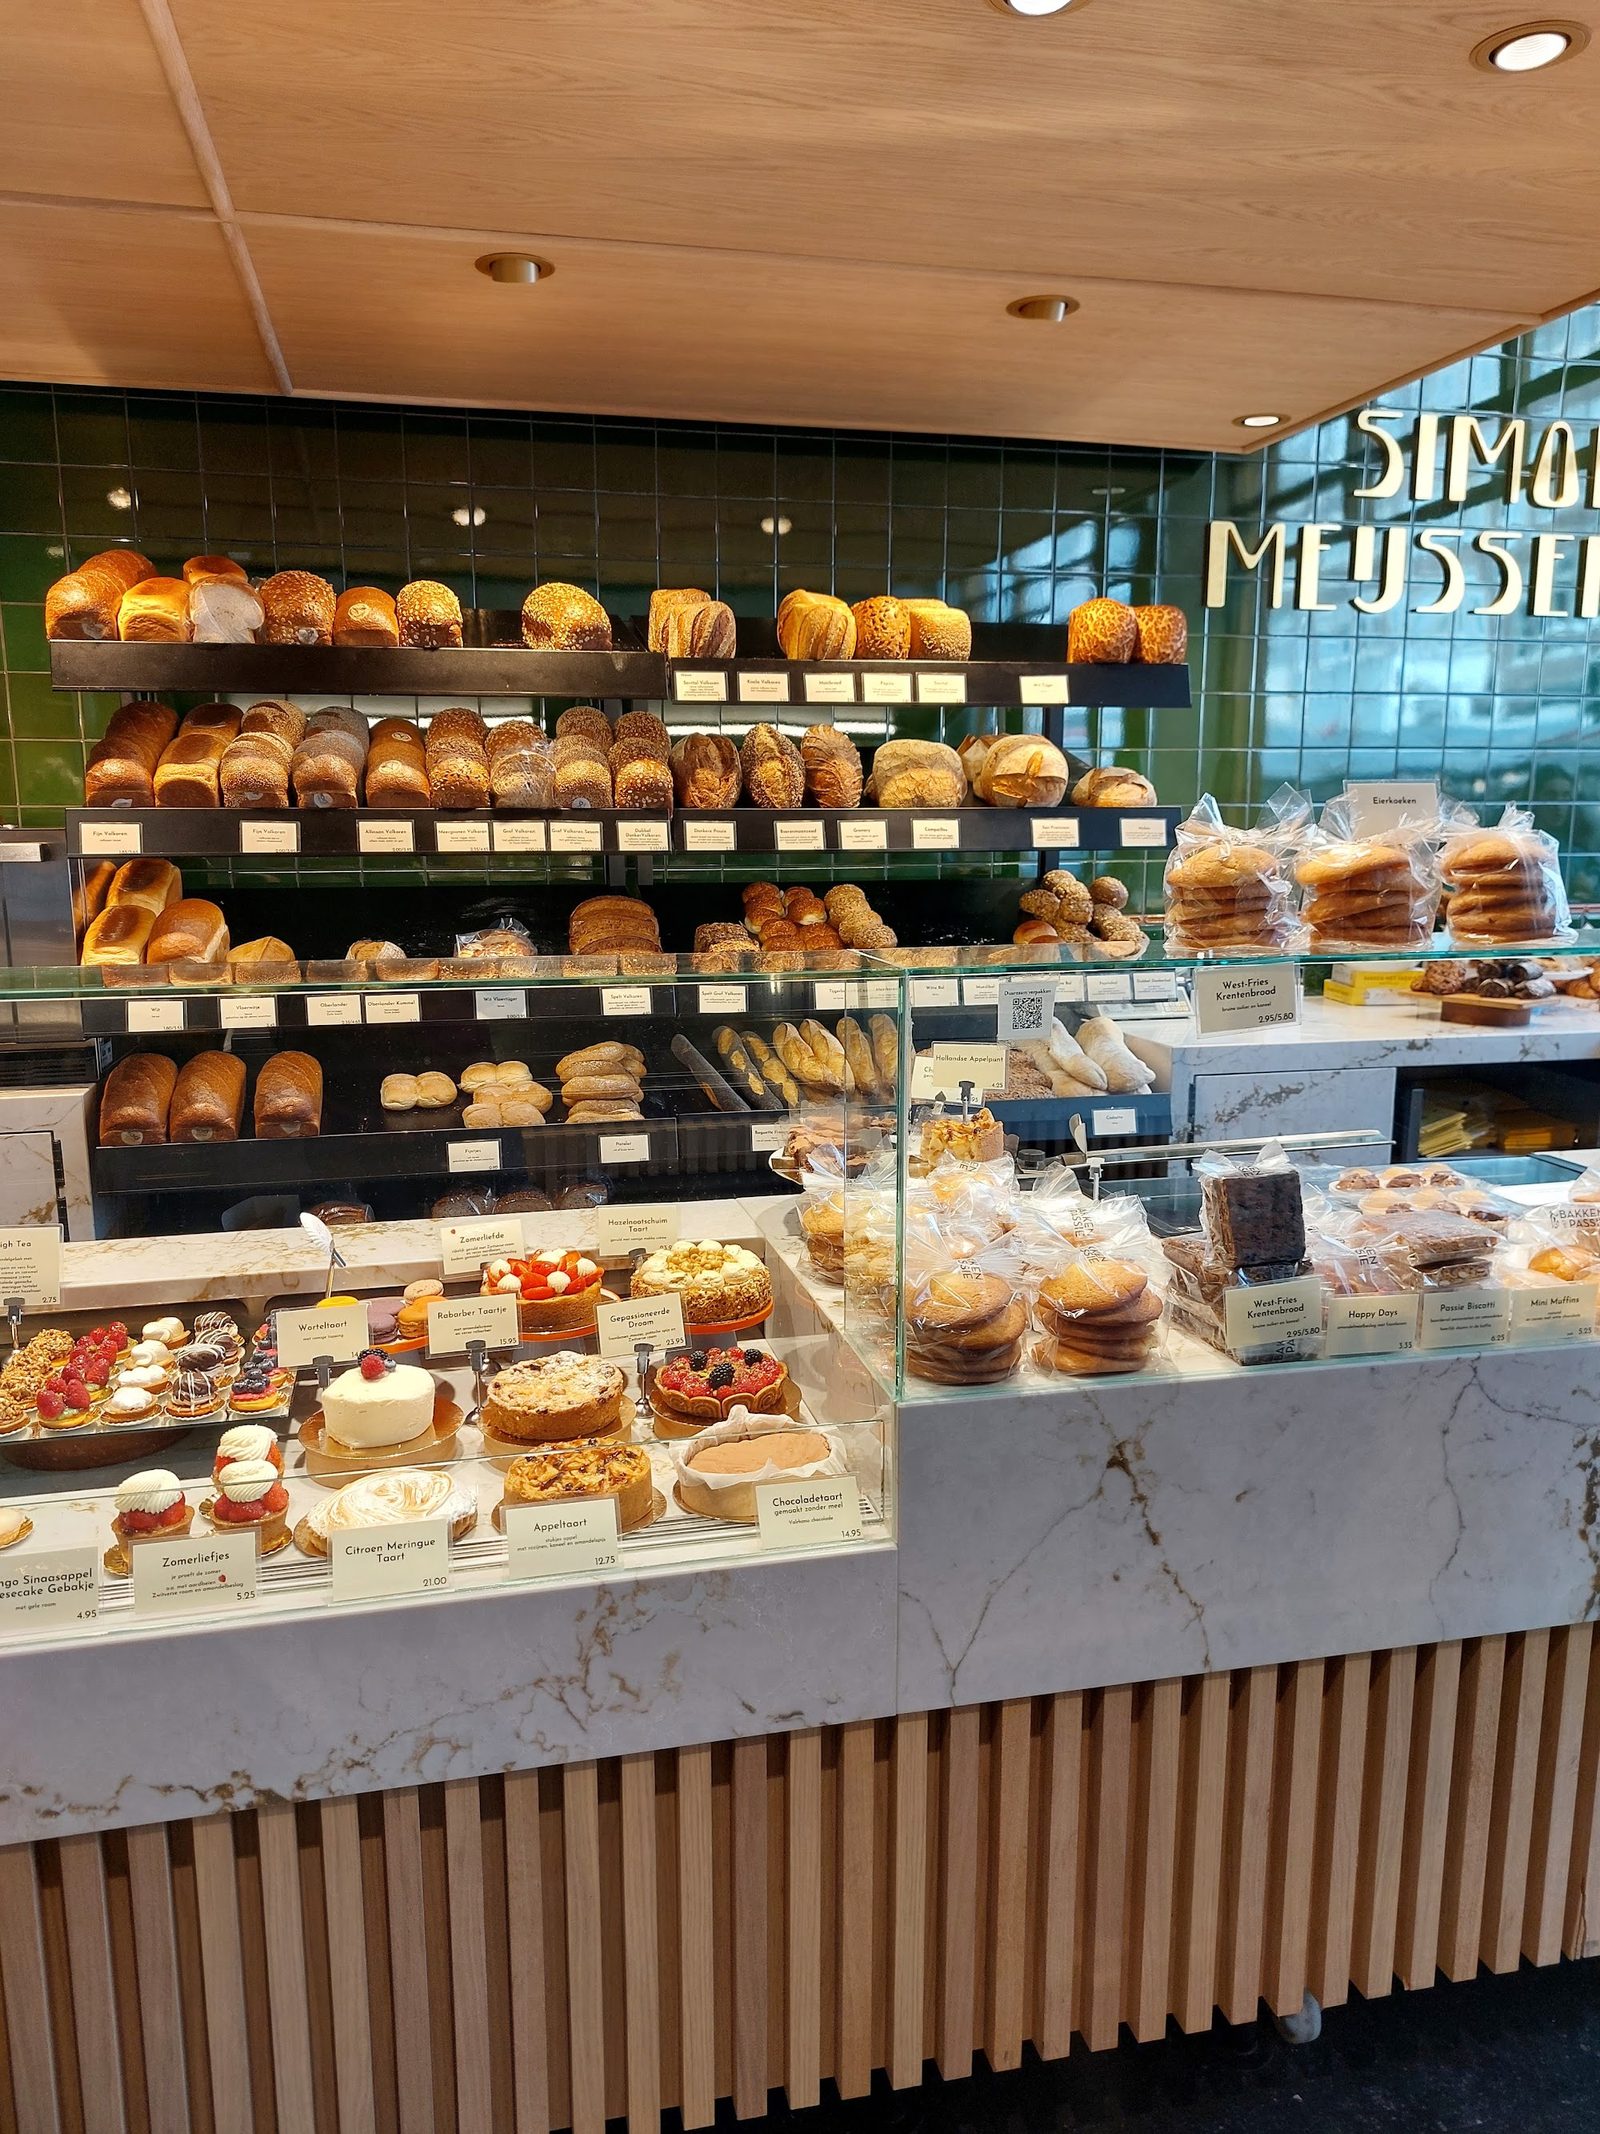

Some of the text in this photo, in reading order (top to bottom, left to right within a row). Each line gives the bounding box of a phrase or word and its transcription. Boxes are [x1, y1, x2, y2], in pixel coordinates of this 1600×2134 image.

[1353, 409, 1600, 508] SIMO
[1373, 796, 1417, 805] Eierkoeken
[1222, 978, 1268, 990] West-Fries
[1216, 986, 1276, 1001] Krentenbrood
[1258, 1012, 1294, 1023] 2.95/5.80
[970, 1056, 1003, 1064] Appelpunt
[608, 1217, 667, 1226] Hazelnootschuim
[460, 1231, 505, 1244] Zomerliefde
[0, 1240, 32, 1250] igh Tea
[1254, 1297, 1298, 1308] West-Fries
[1440, 1301, 1496, 1312] Passie Biscotti
[1530, 1295, 1580, 1307] Mini Muffins
[437, 1306, 507, 1320] Rabarber Taartje
[610, 1307, 670, 1323] Gepassioneerde
[1247, 1303, 1305, 1318] Krentenbrood
[1348, 1308, 1398, 1320] Happy Days
[298, 1320, 347, 1332] Worteltaart
[628, 1320, 654, 1329] Droom
[1287, 1327, 1320, 1338] 2.95/5.80
[1578, 1327, 1592, 1335] 5.25
[499, 1337, 517, 1345] 15.95
[666, 1337, 684, 1346] 23.95
[1491, 1334, 1505, 1342] 6.25
[772, 1492, 843, 1507] Chocoladetaart
[774, 1501, 844, 1516] gemaakt zonder meel
[534, 1518, 587, 1532] Appeltaart
[841, 1529, 861, 1538] 14.95
[345, 1539, 436, 1556] Citroen Meringue
[163, 1551, 230, 1568] Zomerliefjes
[377, 1552, 405, 1563] Taart
[595, 1556, 616, 1566] 12.75
[0, 1567, 92, 1589] ngo Sinaasappel
[422, 1577, 447, 1587] 21.00
[0, 1580, 94, 1599] esecake Gebakje
[237, 1591, 256, 1600] 5.25
[77, 1610, 97, 1619] 4.95
